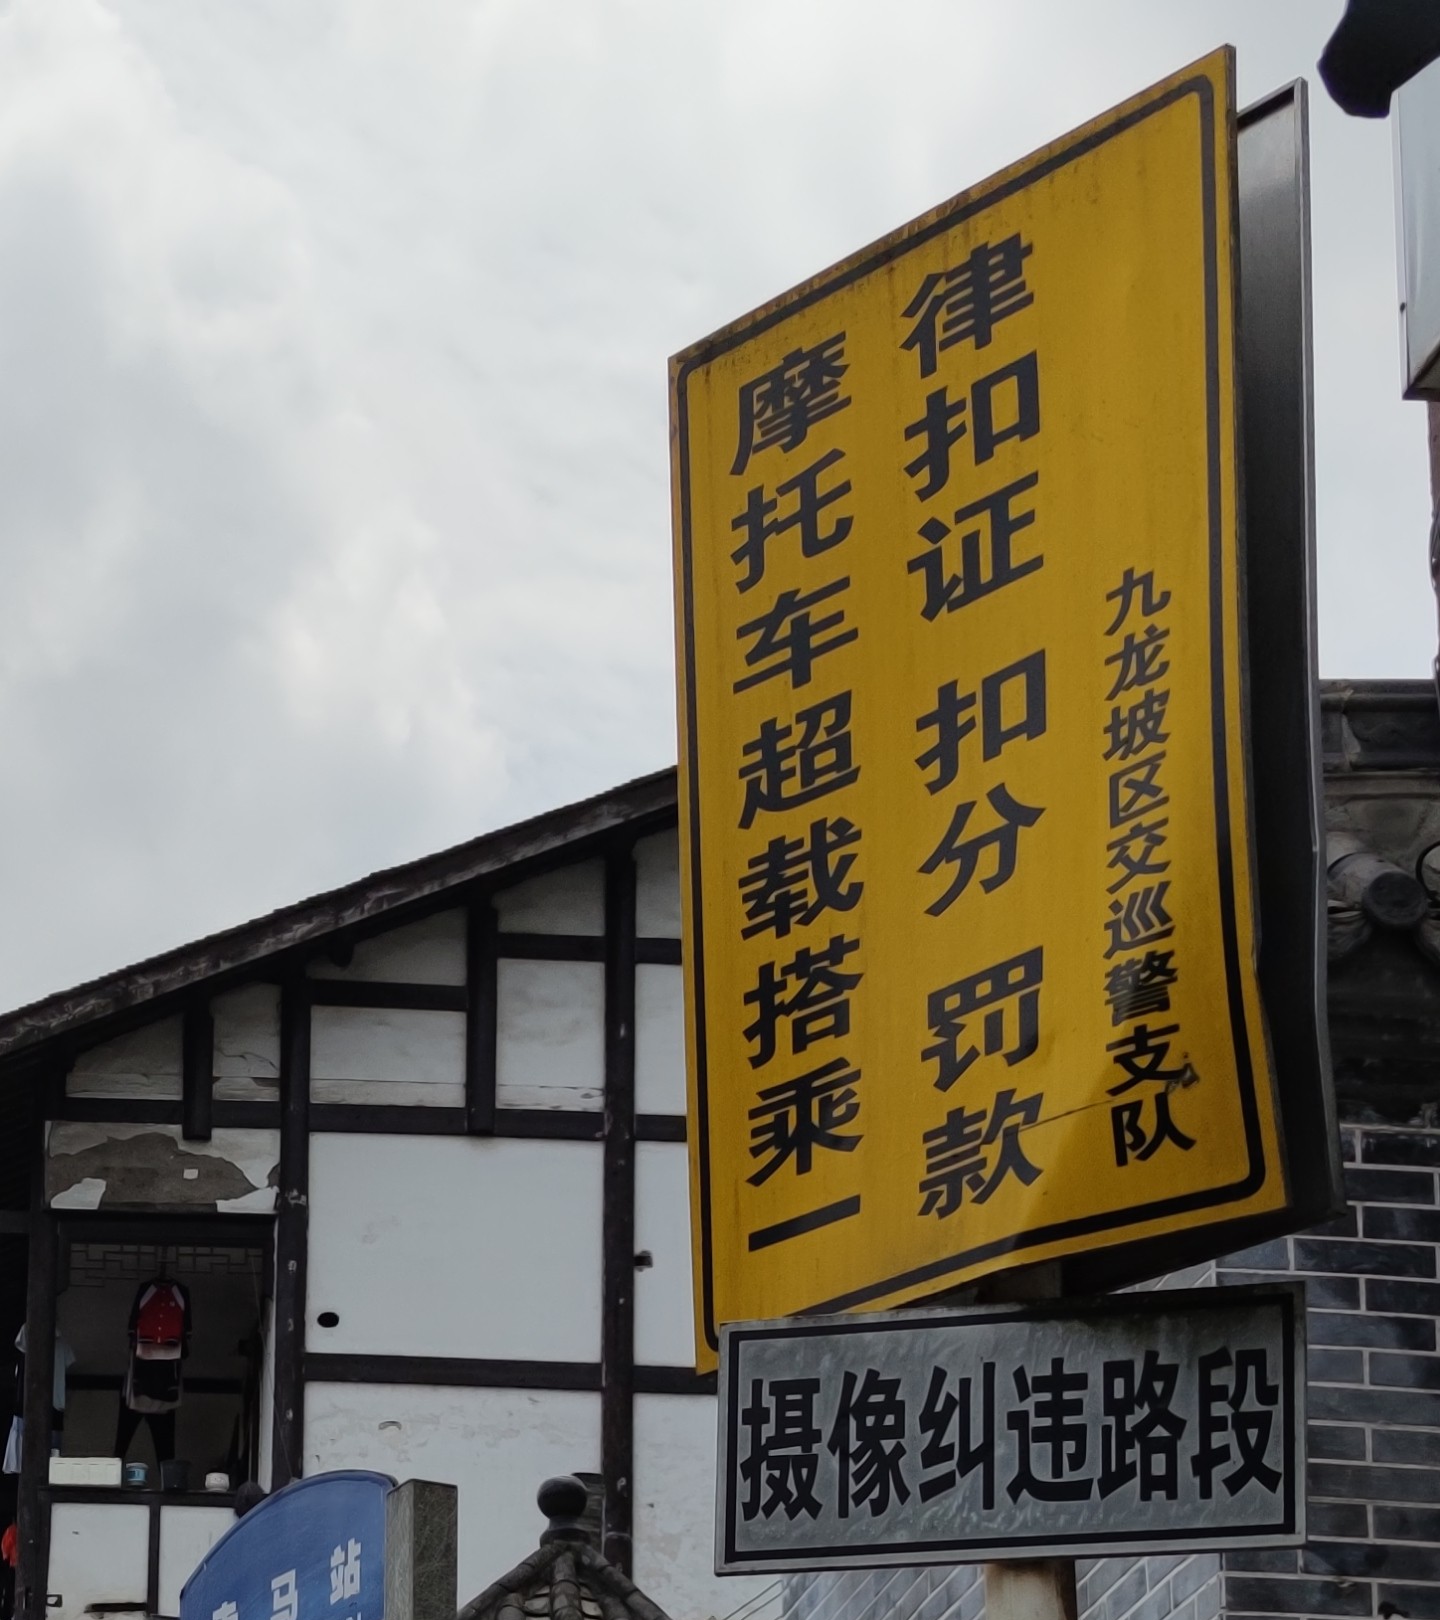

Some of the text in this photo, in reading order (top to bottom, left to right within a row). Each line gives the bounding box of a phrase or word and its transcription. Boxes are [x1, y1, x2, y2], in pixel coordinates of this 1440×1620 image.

[728, 330, 863, 1252] 摩托车超载搭乘一
[898, 232, 1048, 1220] 律扣证 扣分 罚款
[1102, 567, 1197, 1167] 九龙坡区交巡警支队
[740, 1347, 1283, 1521] 摄像纠违路段
